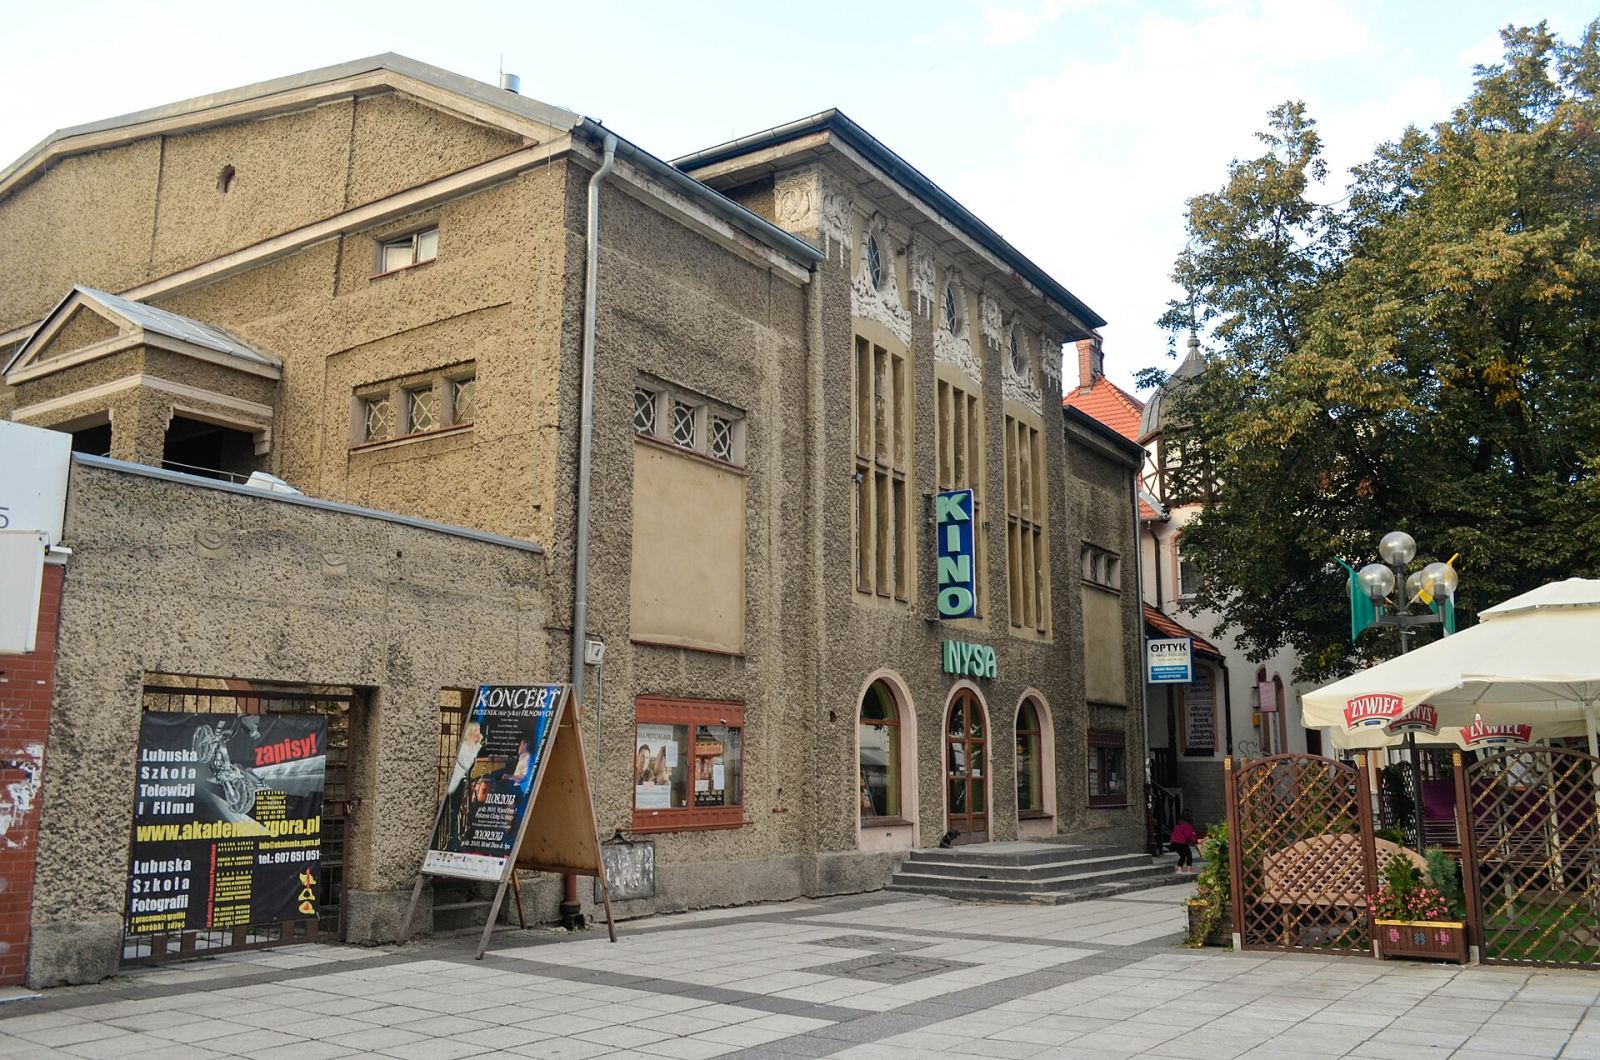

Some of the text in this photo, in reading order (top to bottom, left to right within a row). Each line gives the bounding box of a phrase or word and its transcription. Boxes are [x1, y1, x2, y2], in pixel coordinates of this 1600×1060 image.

[938, 493, 973, 616] KINO
[1150, 643, 1187, 652] OPTYK
[943, 640, 998, 679] NYSA
[475, 687, 561, 709] KONCERT
[142, 748, 199, 762] Lubuska
[255, 733, 317, 766] zapisy!
[141, 766, 197, 779] Szkoła
[140, 783, 196, 798] Telewizji
[138, 801, 195, 815] i Filmu
[136, 815, 321, 842] www.akademia.zgora.pl
[258, 853, 274, 865] tel.:
[275, 851, 290, 863] 607
[290, 850, 305, 863] 651
[305, 849, 320, 861] 051
[133, 858, 192, 875] Lubuska
[132, 877, 190, 894] Szkoła
[131, 894, 189, 913] Fotografii
